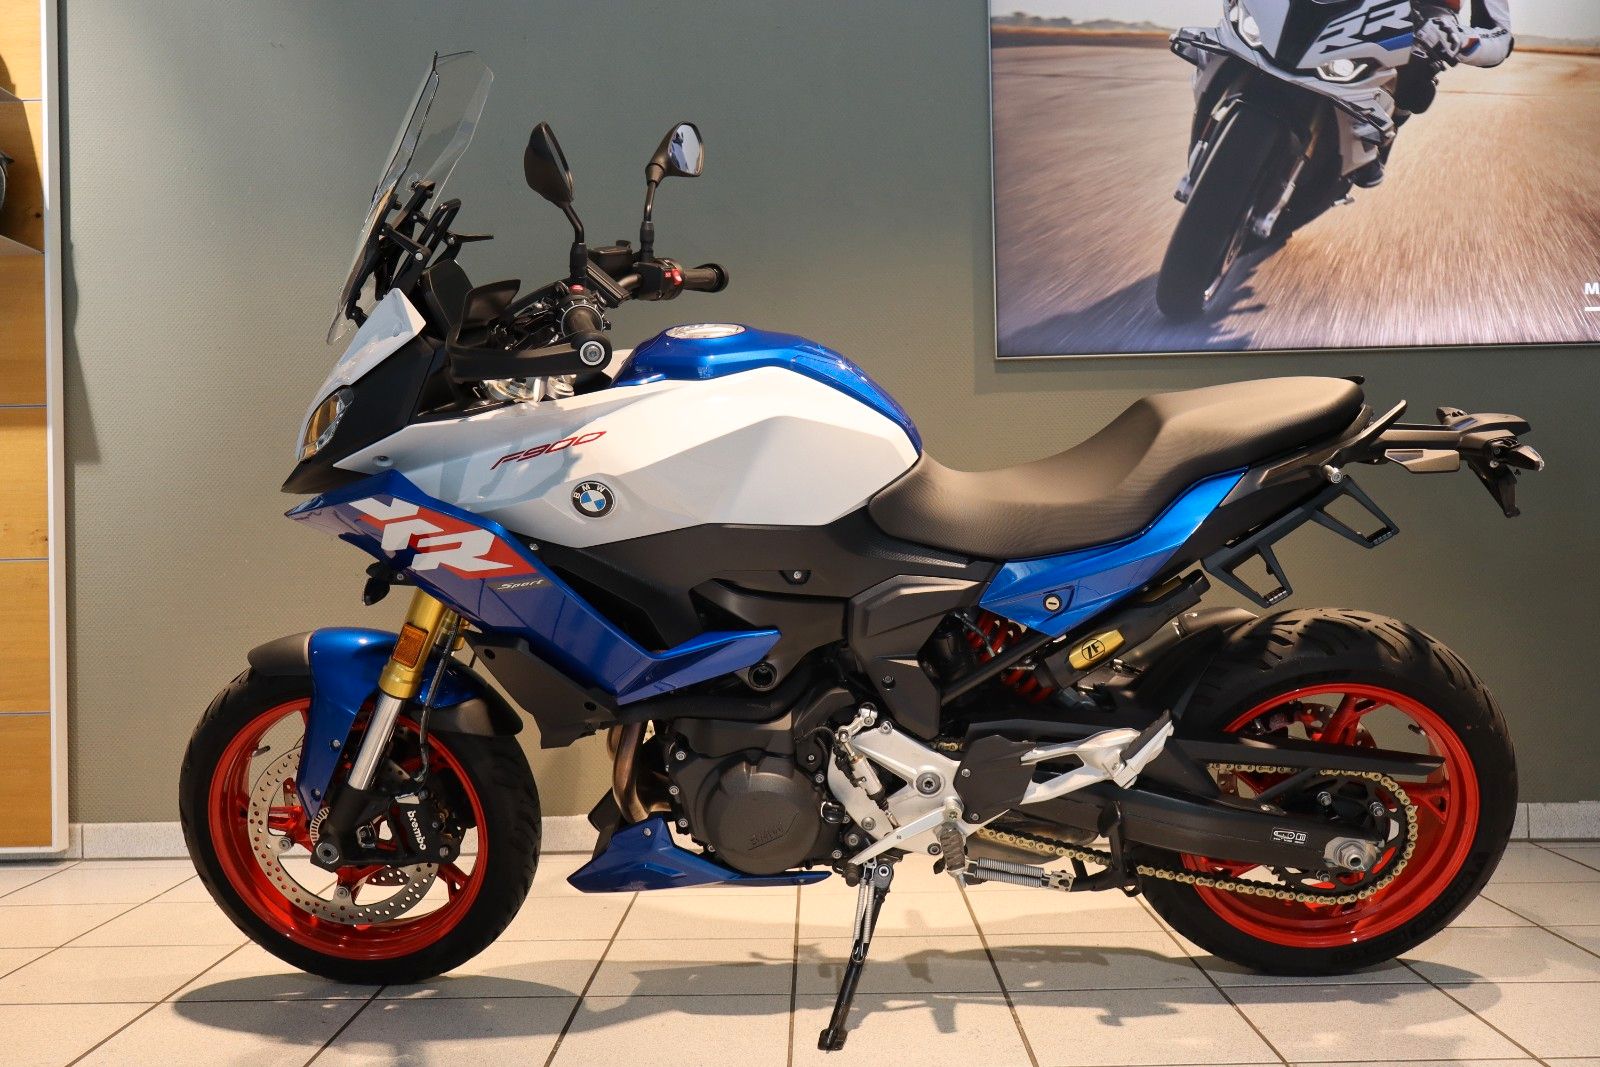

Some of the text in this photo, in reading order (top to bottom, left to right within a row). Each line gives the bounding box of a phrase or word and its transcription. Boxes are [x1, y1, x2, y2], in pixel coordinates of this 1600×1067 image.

[490, 431, 607, 470] F900
[572, 483, 606, 500] BMW
[348, 497, 513, 571] XR
[497, 579, 544, 590] Sport
[1082, 640, 1105, 660] ZF
[406, 810, 427, 850] brembo
